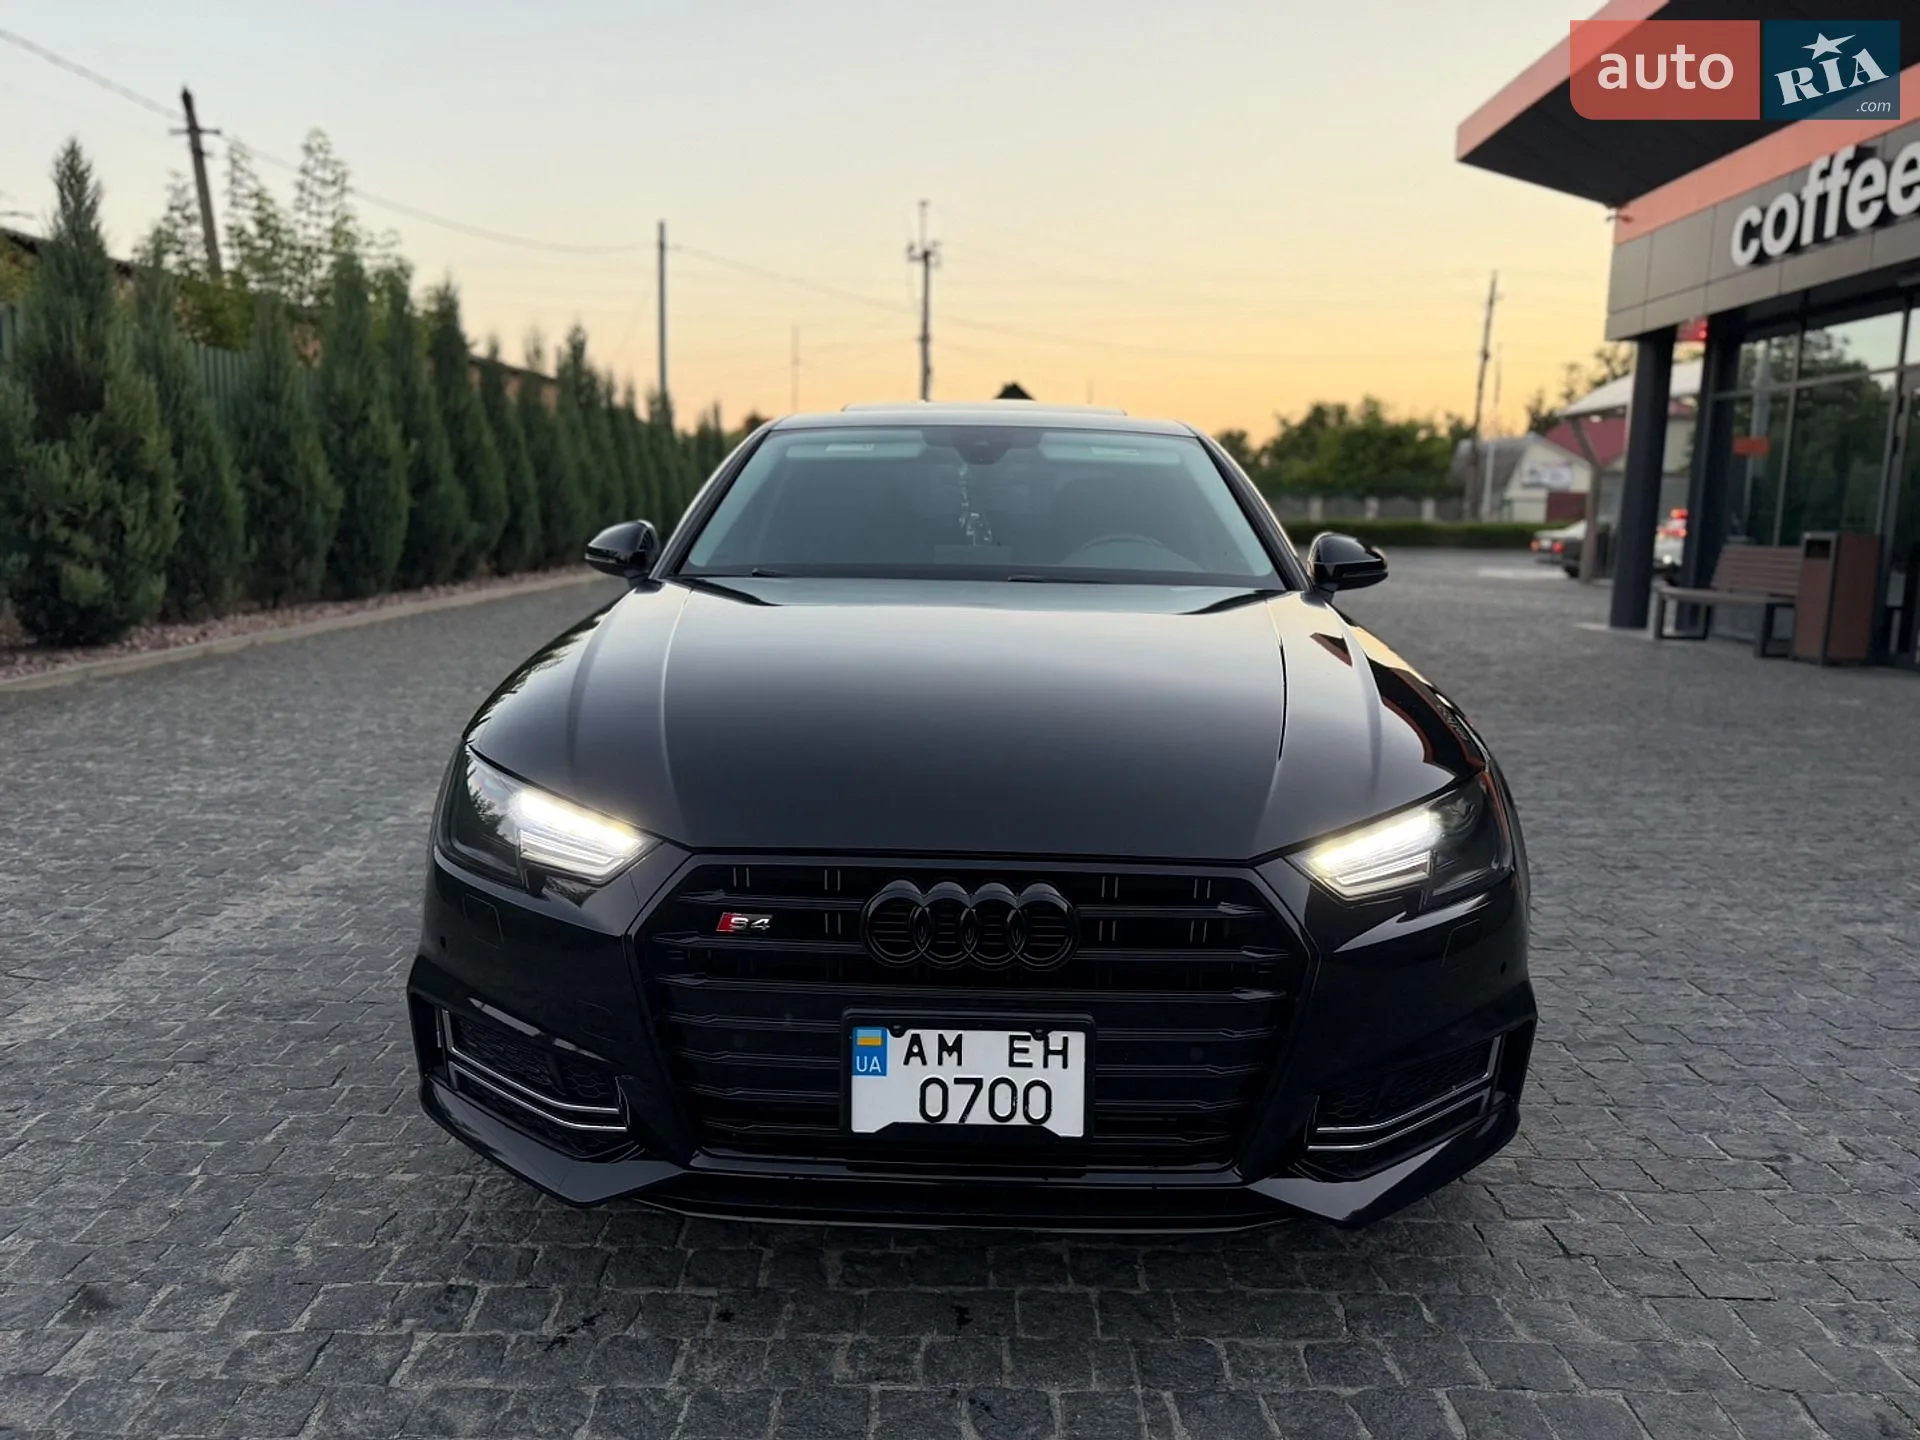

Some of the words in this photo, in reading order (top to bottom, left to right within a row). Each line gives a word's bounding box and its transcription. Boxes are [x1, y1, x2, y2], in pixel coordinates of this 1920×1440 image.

[1731, 141, 1920, 267] coffee
[728, 917, 771, 931] S4
[856, 1056, 882, 1073] UA
[903, 1033, 963, 1066] AM
[1008, 1034, 1069, 1069] EH
[919, 1077, 1052, 1125] 0700
